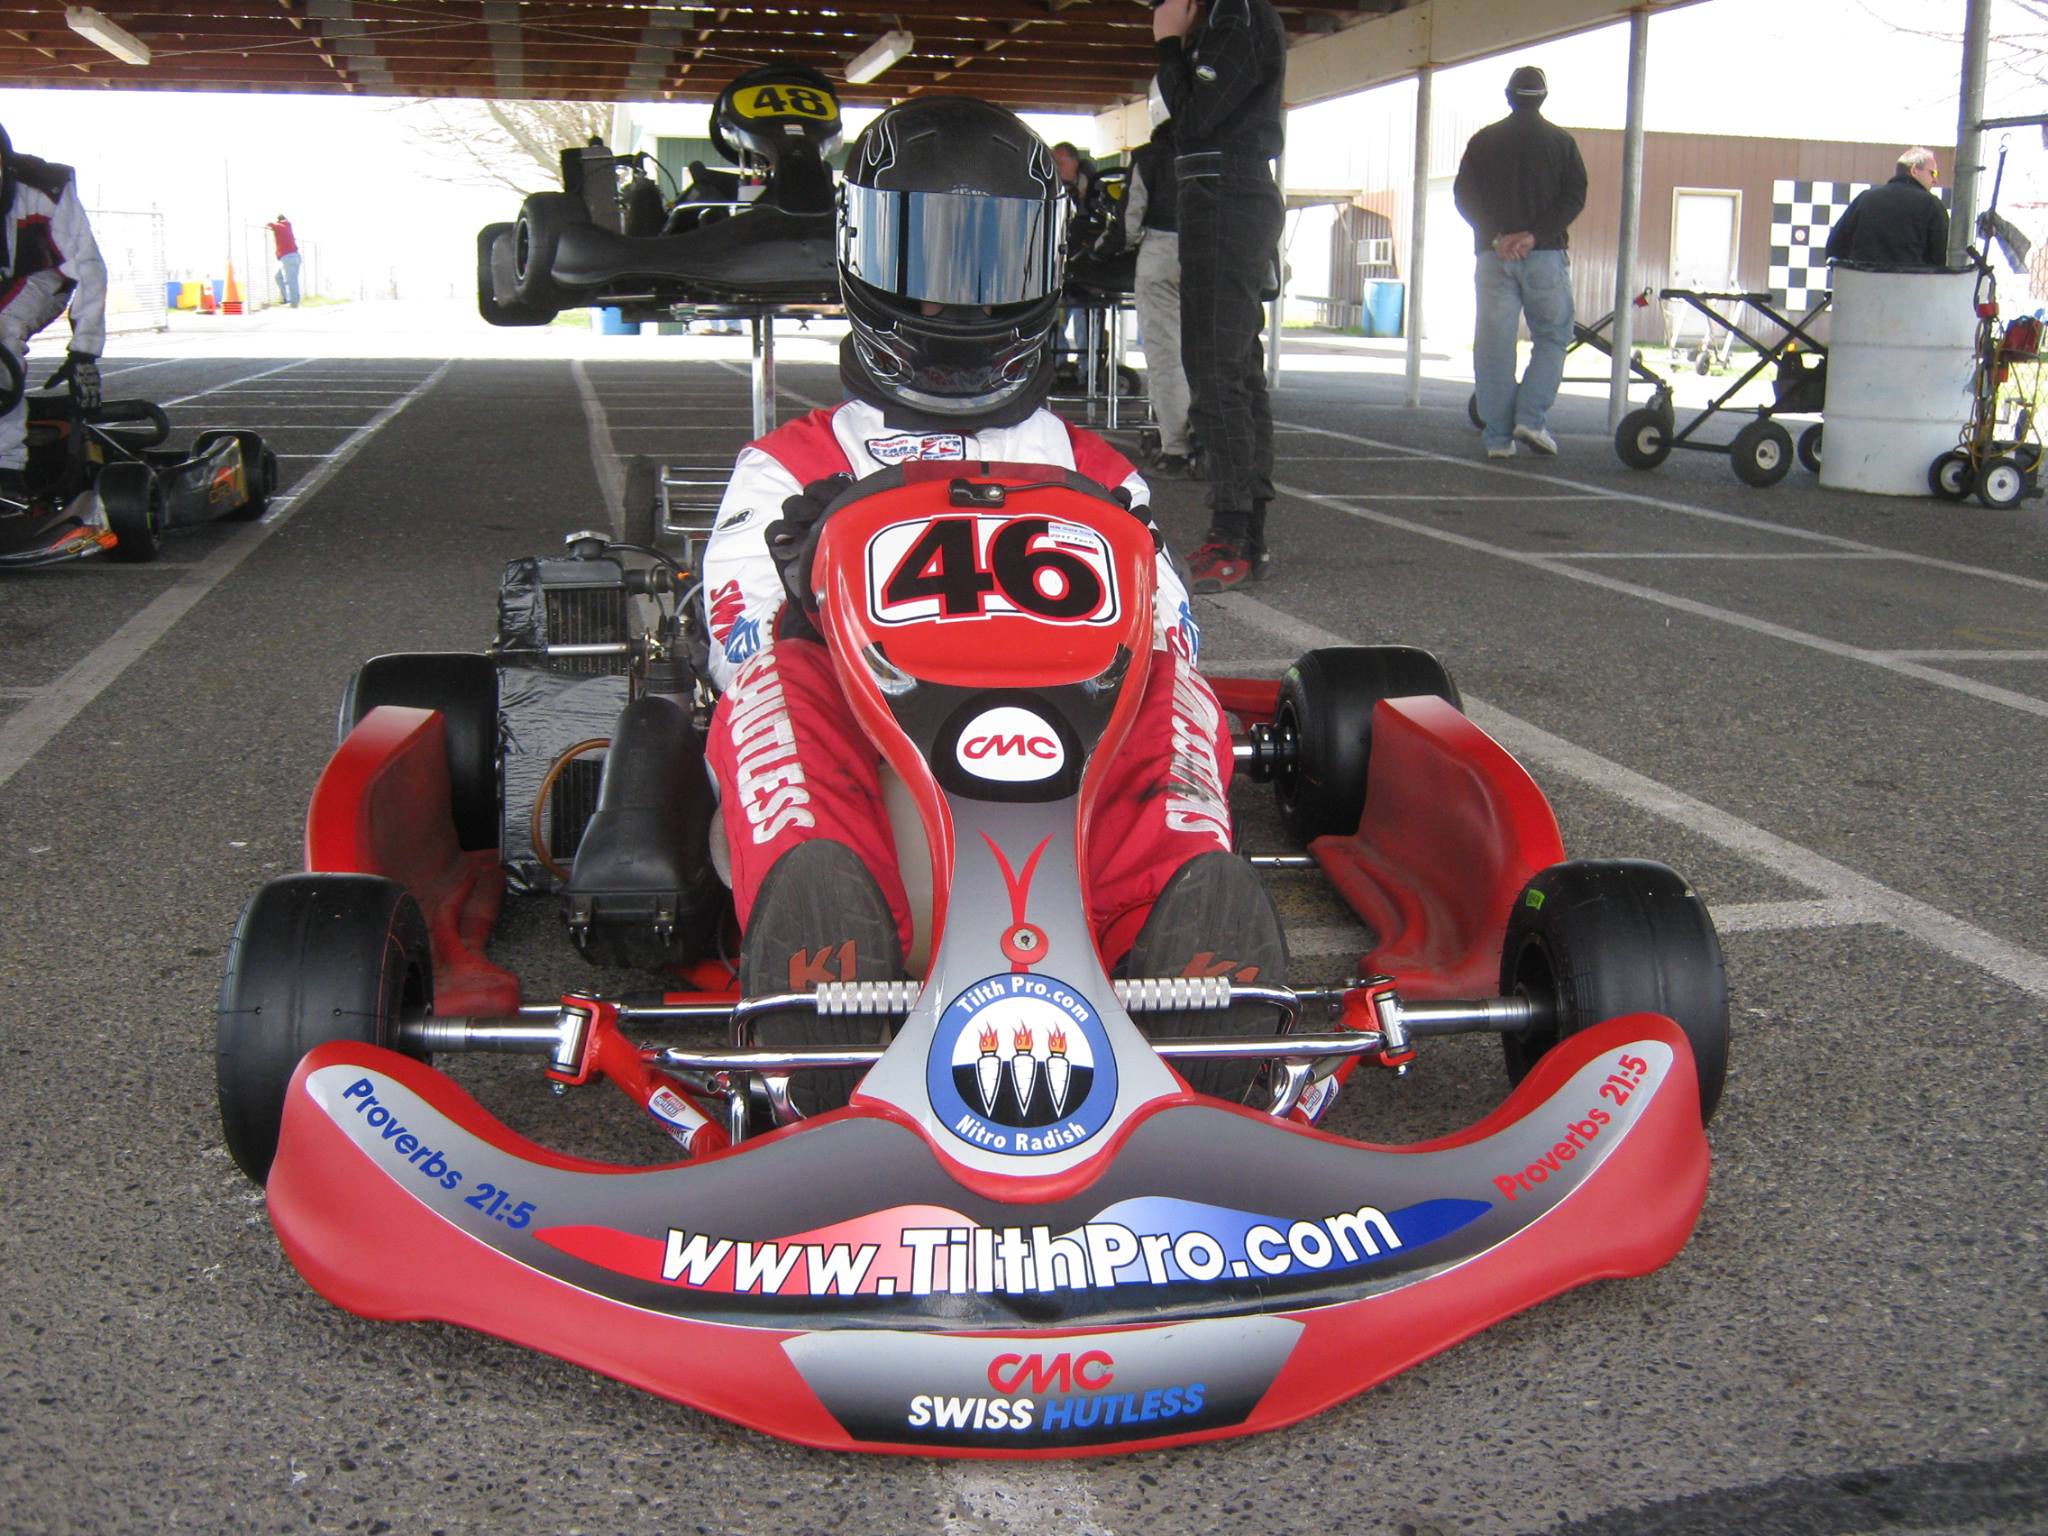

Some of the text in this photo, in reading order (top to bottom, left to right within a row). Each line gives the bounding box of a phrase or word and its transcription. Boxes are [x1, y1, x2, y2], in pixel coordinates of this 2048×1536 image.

[754, 87, 828, 116] 48
[881, 516, 1105, 622] 46
[961, 732, 1058, 761] CMC
[788, 938, 857, 993] K1
[956, 976, 1090, 1023] Tilth Pro.com
[956, 1114, 1087, 1152] Nitro Radish
[1493, 1054, 1648, 1202] Proverbs 21:5
[342, 1077, 537, 1230] Proverbs 21:5
[661, 1203, 1404, 1298] www.TilthPro.com
[986, 1350, 1114, 1394] CMC
[907, 1383, 1206, 1431] SWISS HUTLESS
